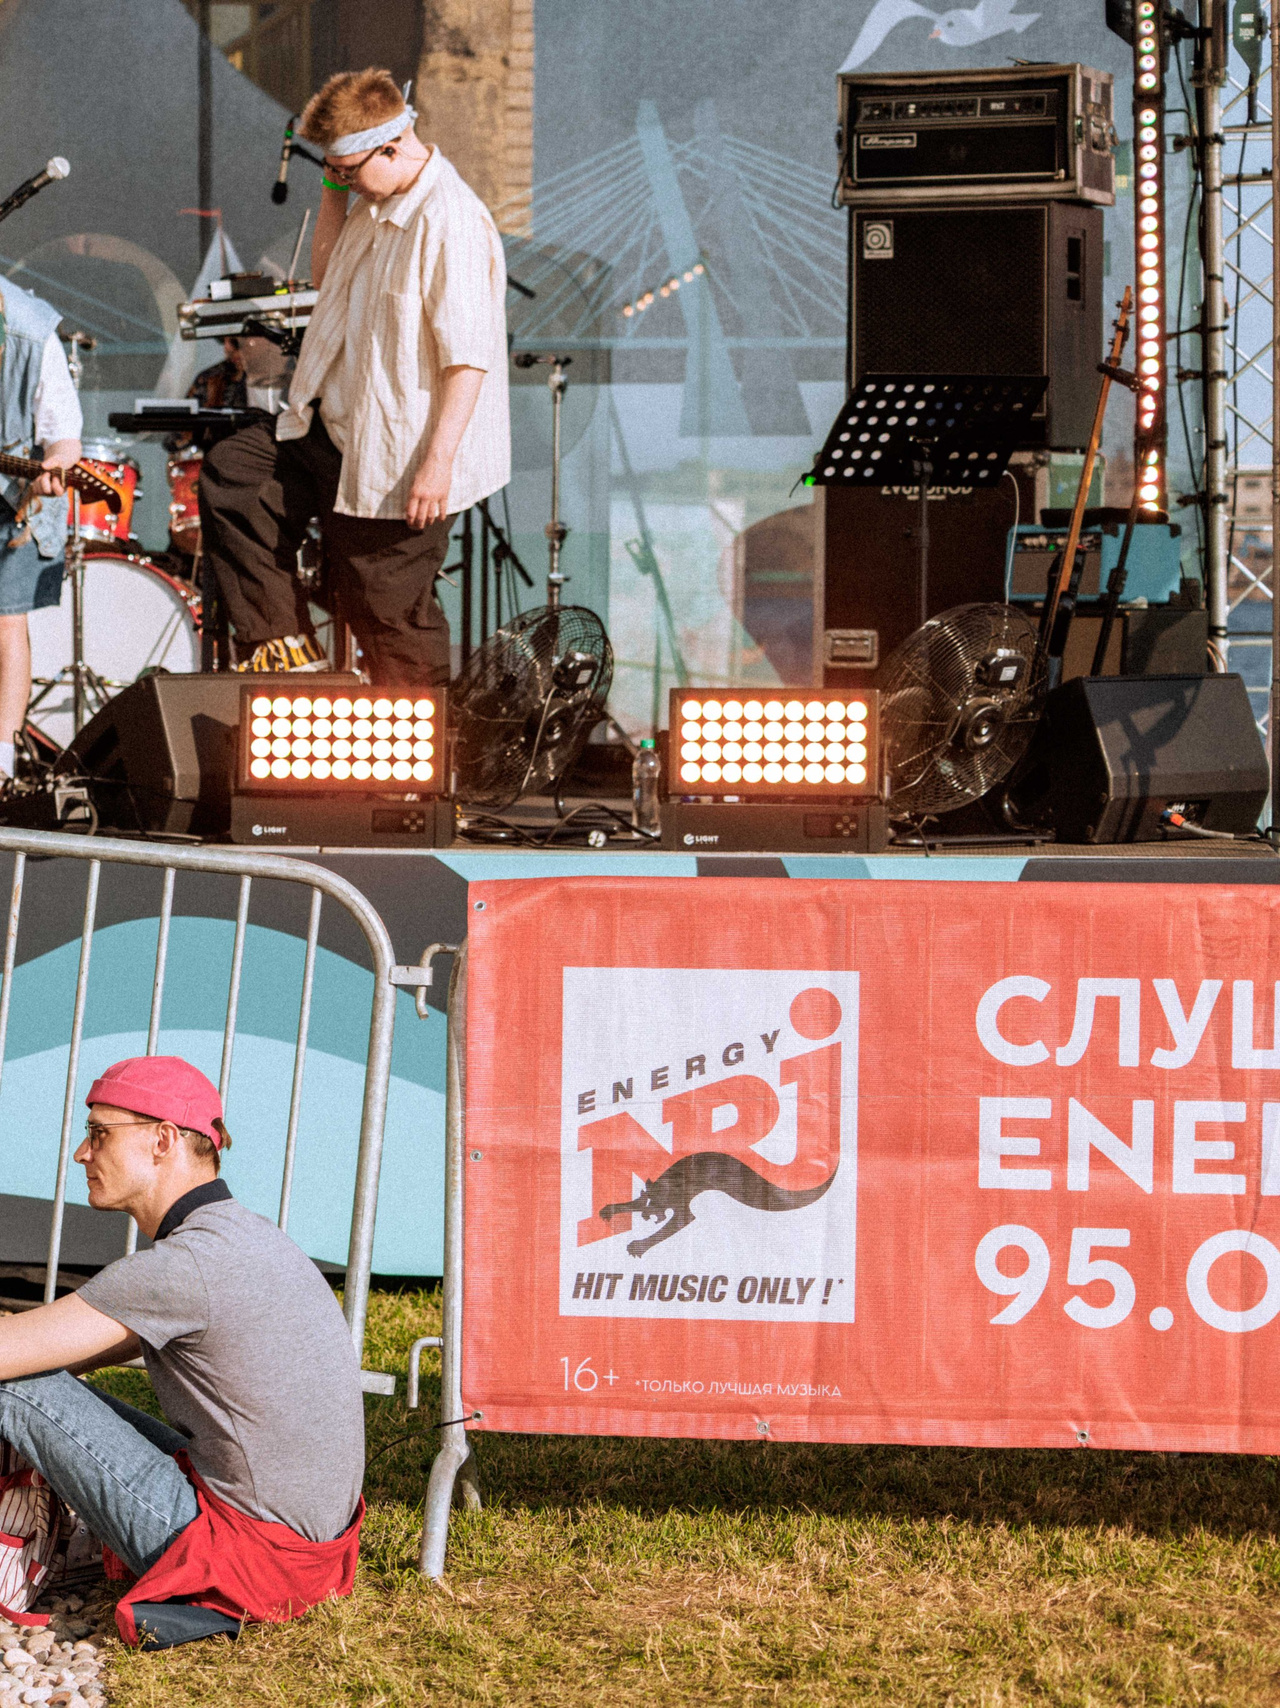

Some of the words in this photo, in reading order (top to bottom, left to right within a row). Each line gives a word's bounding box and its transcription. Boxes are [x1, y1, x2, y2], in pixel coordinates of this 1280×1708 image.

[695, 835, 719, 843] LIGHT
[577, 1029, 781, 1115] ENERGY
[978, 1097, 1280, 1196] ENE
[572, 1273, 623, 1300] HIT
[629, 1274, 729, 1303] MUSIC
[737, 1276, 815, 1305] ONLY
[560, 1357, 619, 1392] 16+
[708, 1381, 771, 1395] ЛУЧШАЯ
[777, 1383, 842, 1397] МУЗЫКА
